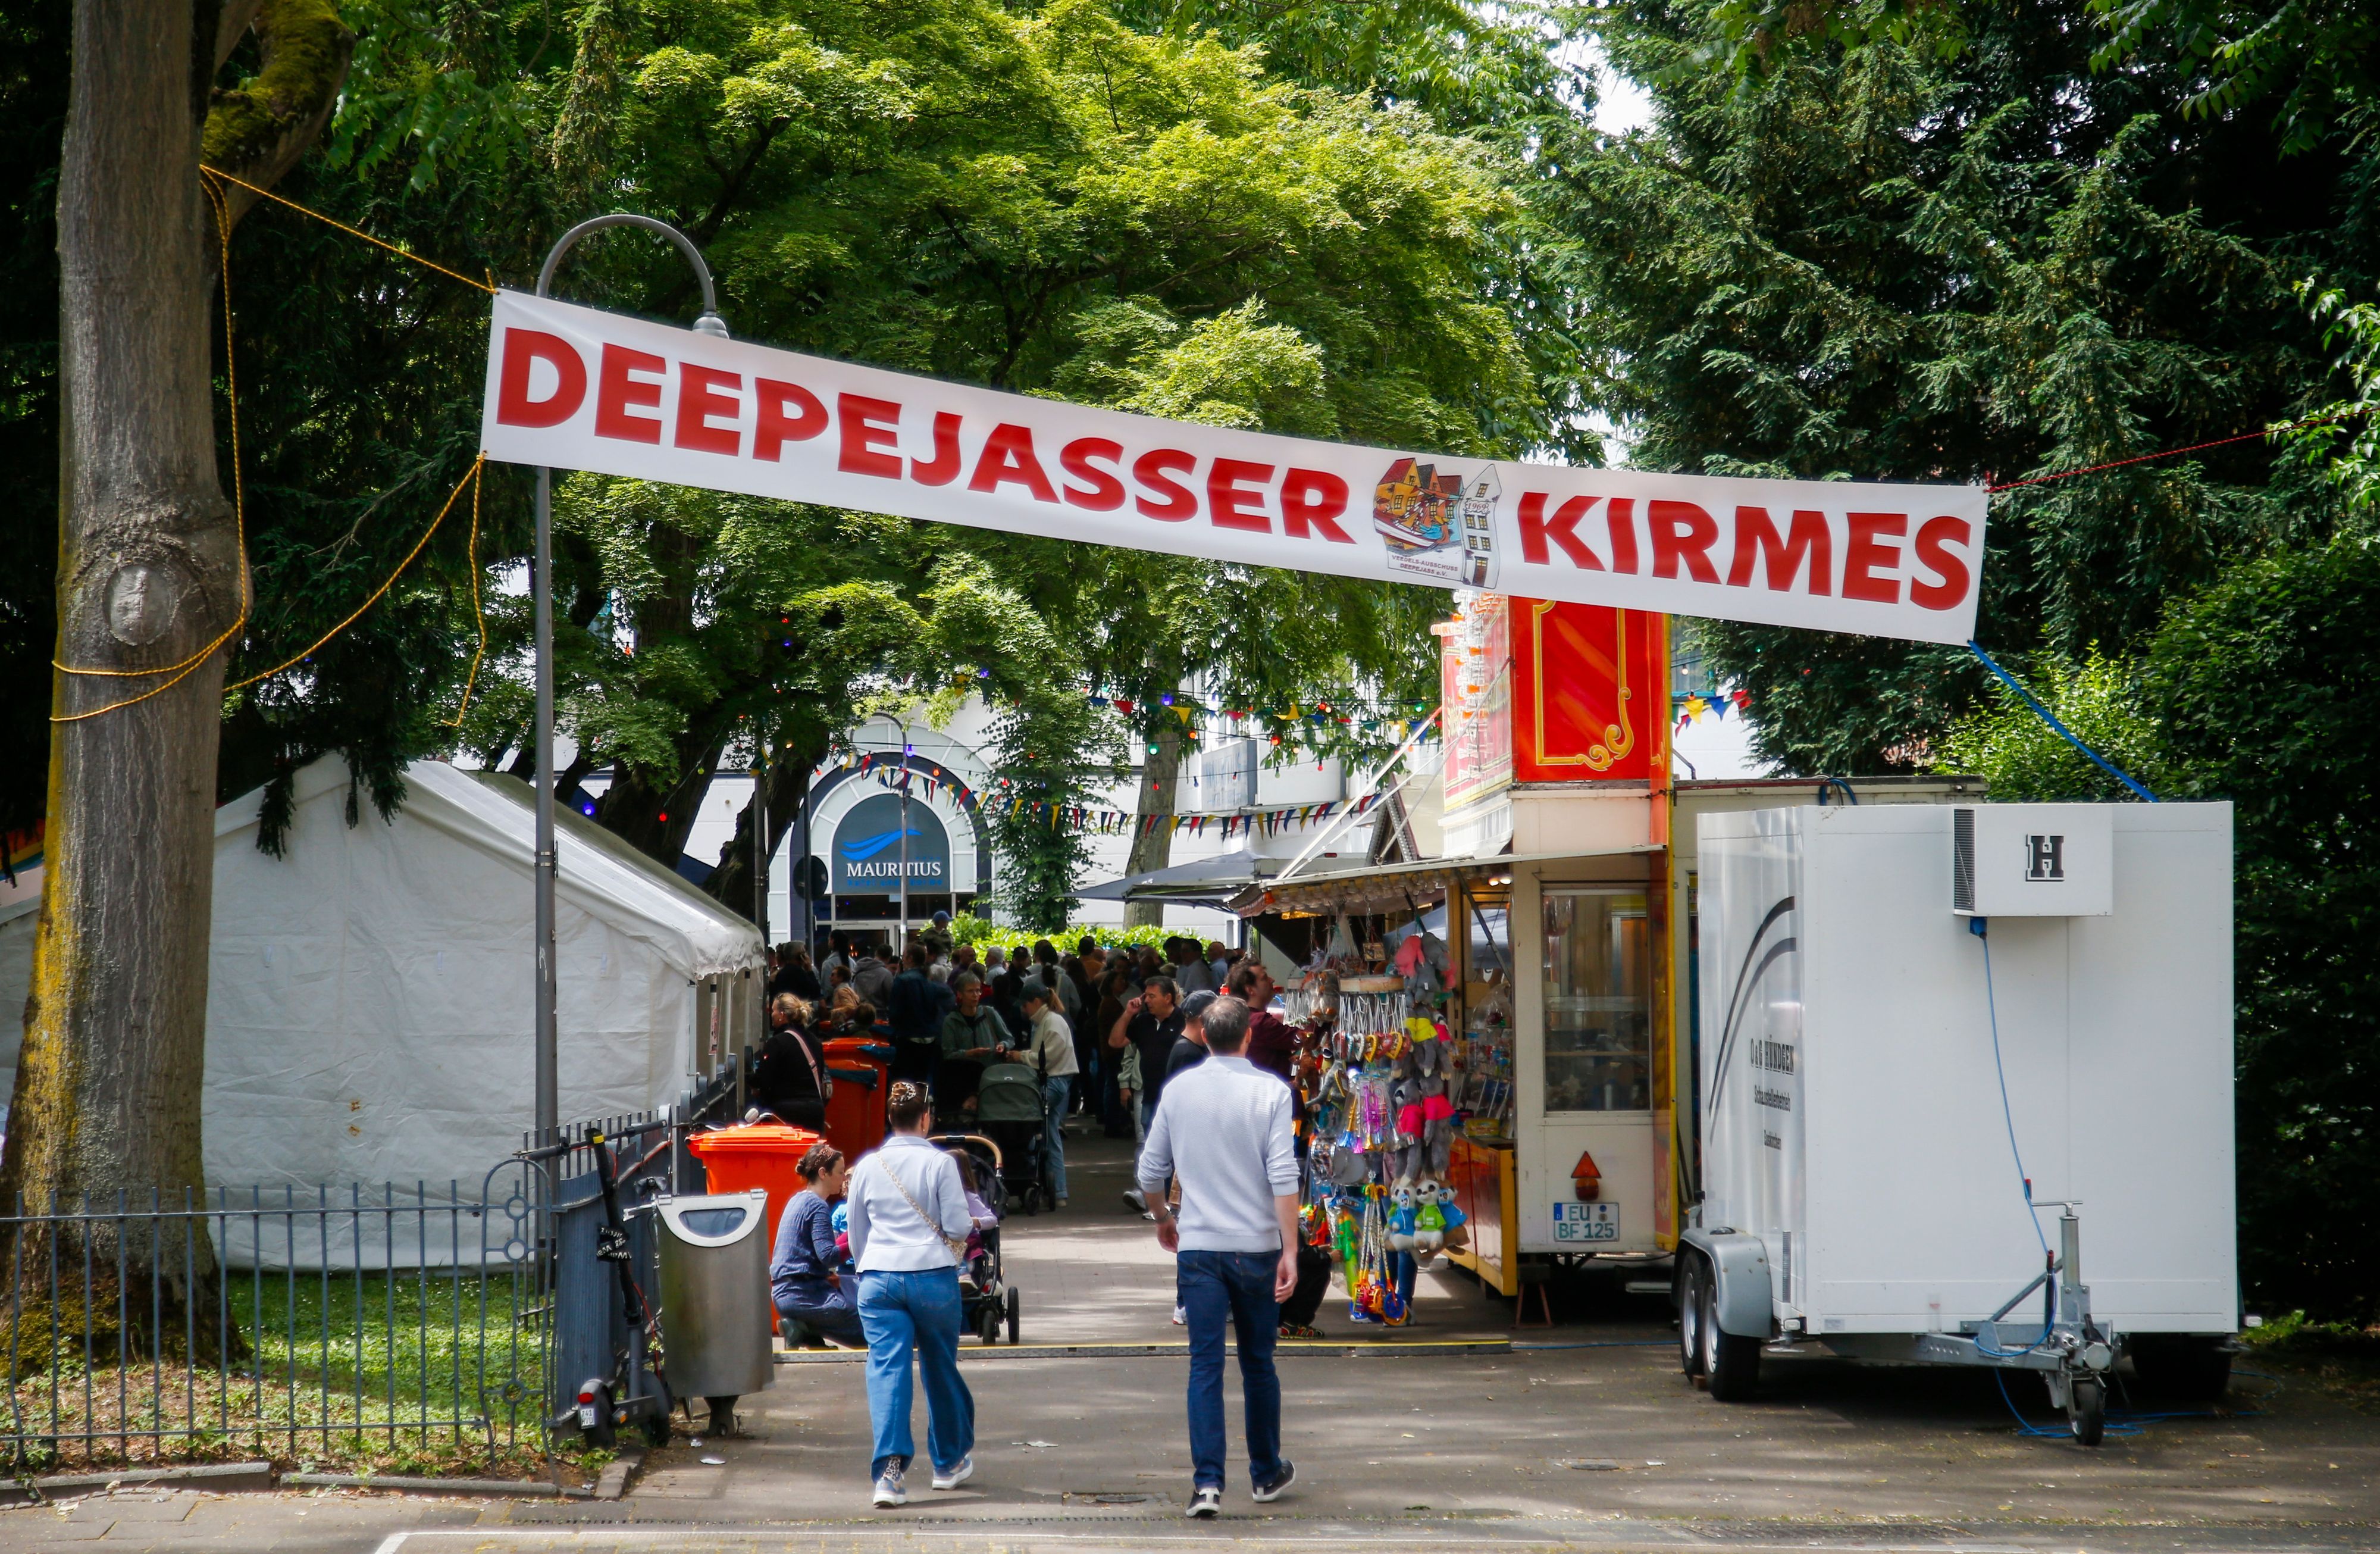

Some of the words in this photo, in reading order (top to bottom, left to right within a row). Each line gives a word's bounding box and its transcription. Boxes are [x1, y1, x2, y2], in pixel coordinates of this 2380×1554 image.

[496, 327, 1357, 545] DEEPEJASSER
[1517, 492, 1971, 611] KIRMES
[1468, 502, 1487, 511] 1969
[1392, 555, 1458, 572] VEEDELS-AUSSCHUSS
[1400, 563, 1435, 574] DEEPEJASS
[2025, 834, 2065, 882] H
[847, 862, 942, 877] MAURITIUS
[1569, 1206, 1590, 1221] EU
[1559, 1223, 1579, 1239] BF
[1584, 1223, 1614, 1239] 125
